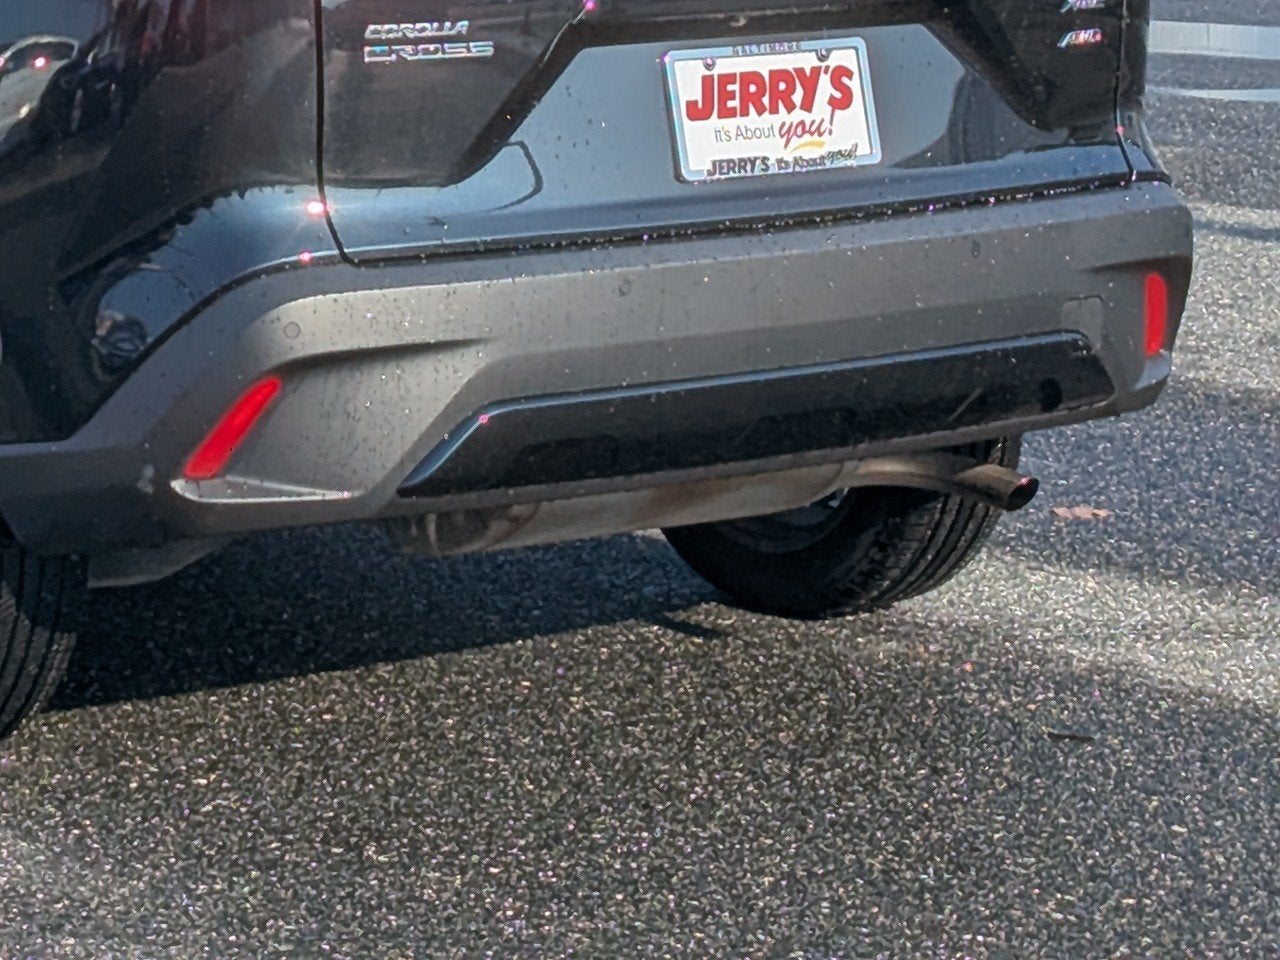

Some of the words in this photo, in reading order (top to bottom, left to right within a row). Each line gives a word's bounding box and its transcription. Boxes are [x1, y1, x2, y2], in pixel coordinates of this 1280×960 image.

[364, 20, 470, 39] COROLLA
[363, 41, 495, 63] CROSS
[685, 64, 855, 122] JERRY'S
[735, 124, 776, 141] About
[778, 108, 835, 150] you!
[706, 155, 770, 177] JERRY'S
